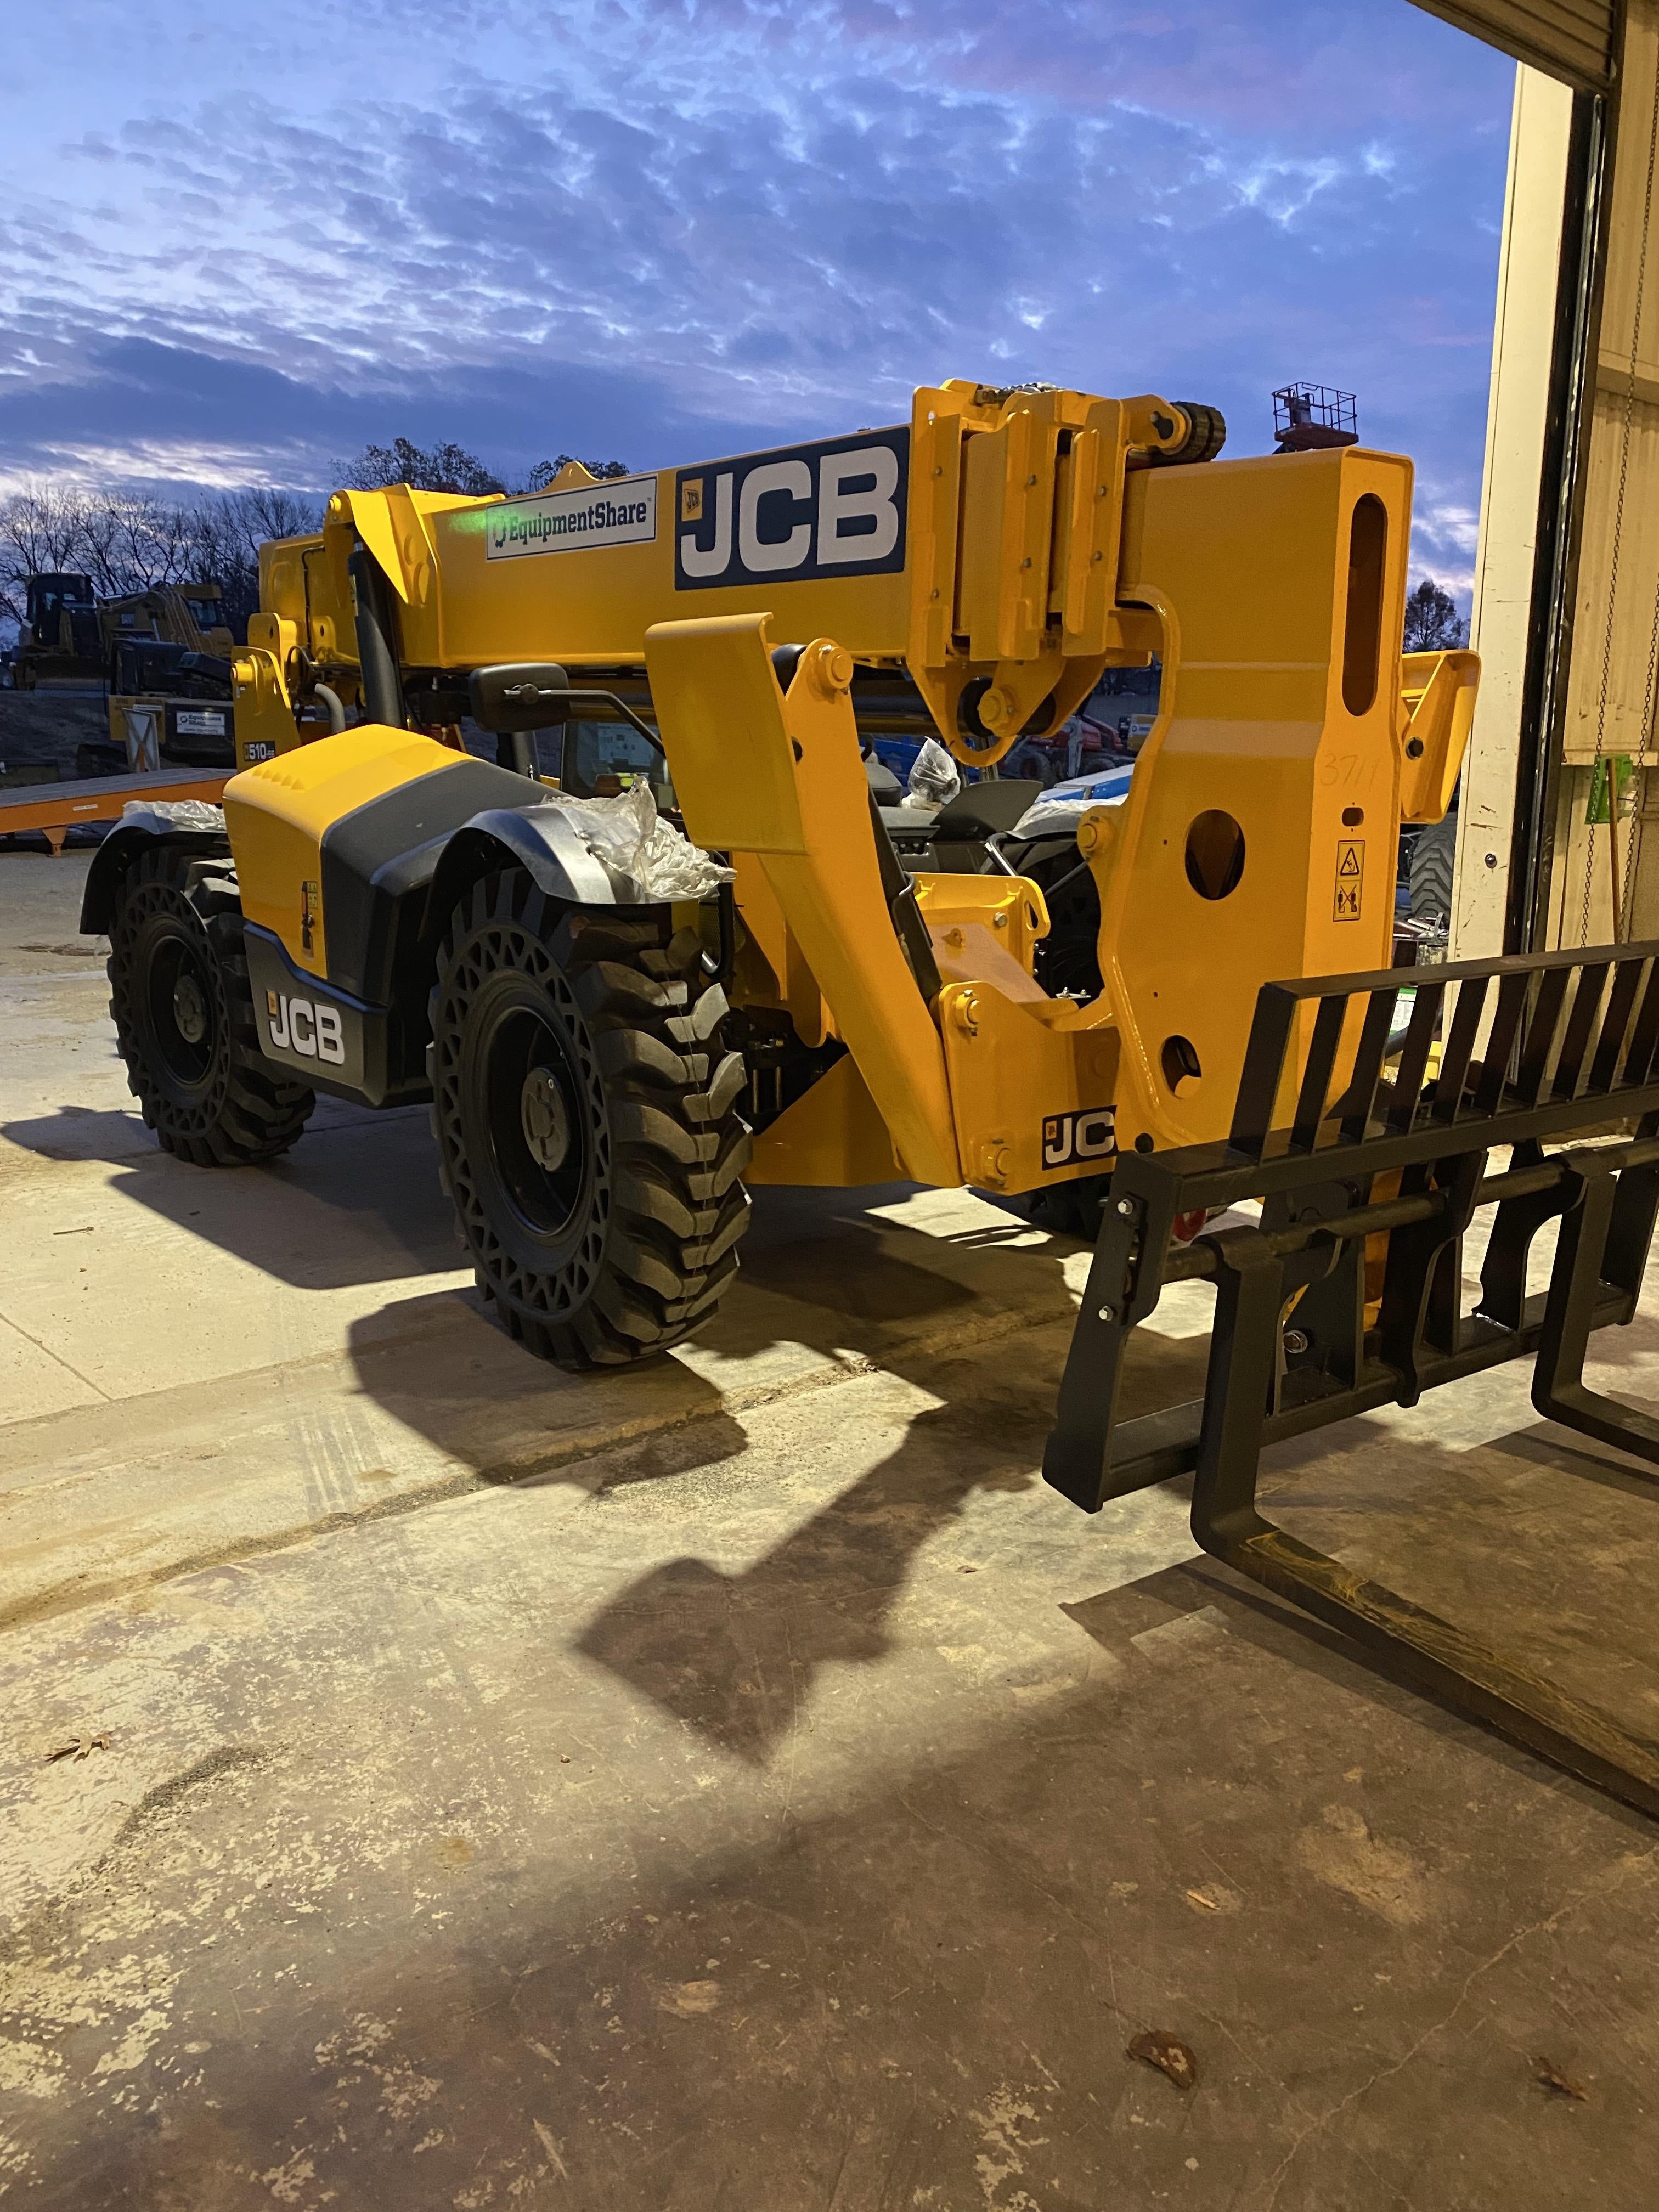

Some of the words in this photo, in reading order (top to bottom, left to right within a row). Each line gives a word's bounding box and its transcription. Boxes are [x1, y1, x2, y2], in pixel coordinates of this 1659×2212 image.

[509, 500, 647, 545] EquipmentShare
[681, 445, 899, 578] JCB
[270, 995, 345, 1064] JCB
[1045, 1111, 1115, 1164] JC
